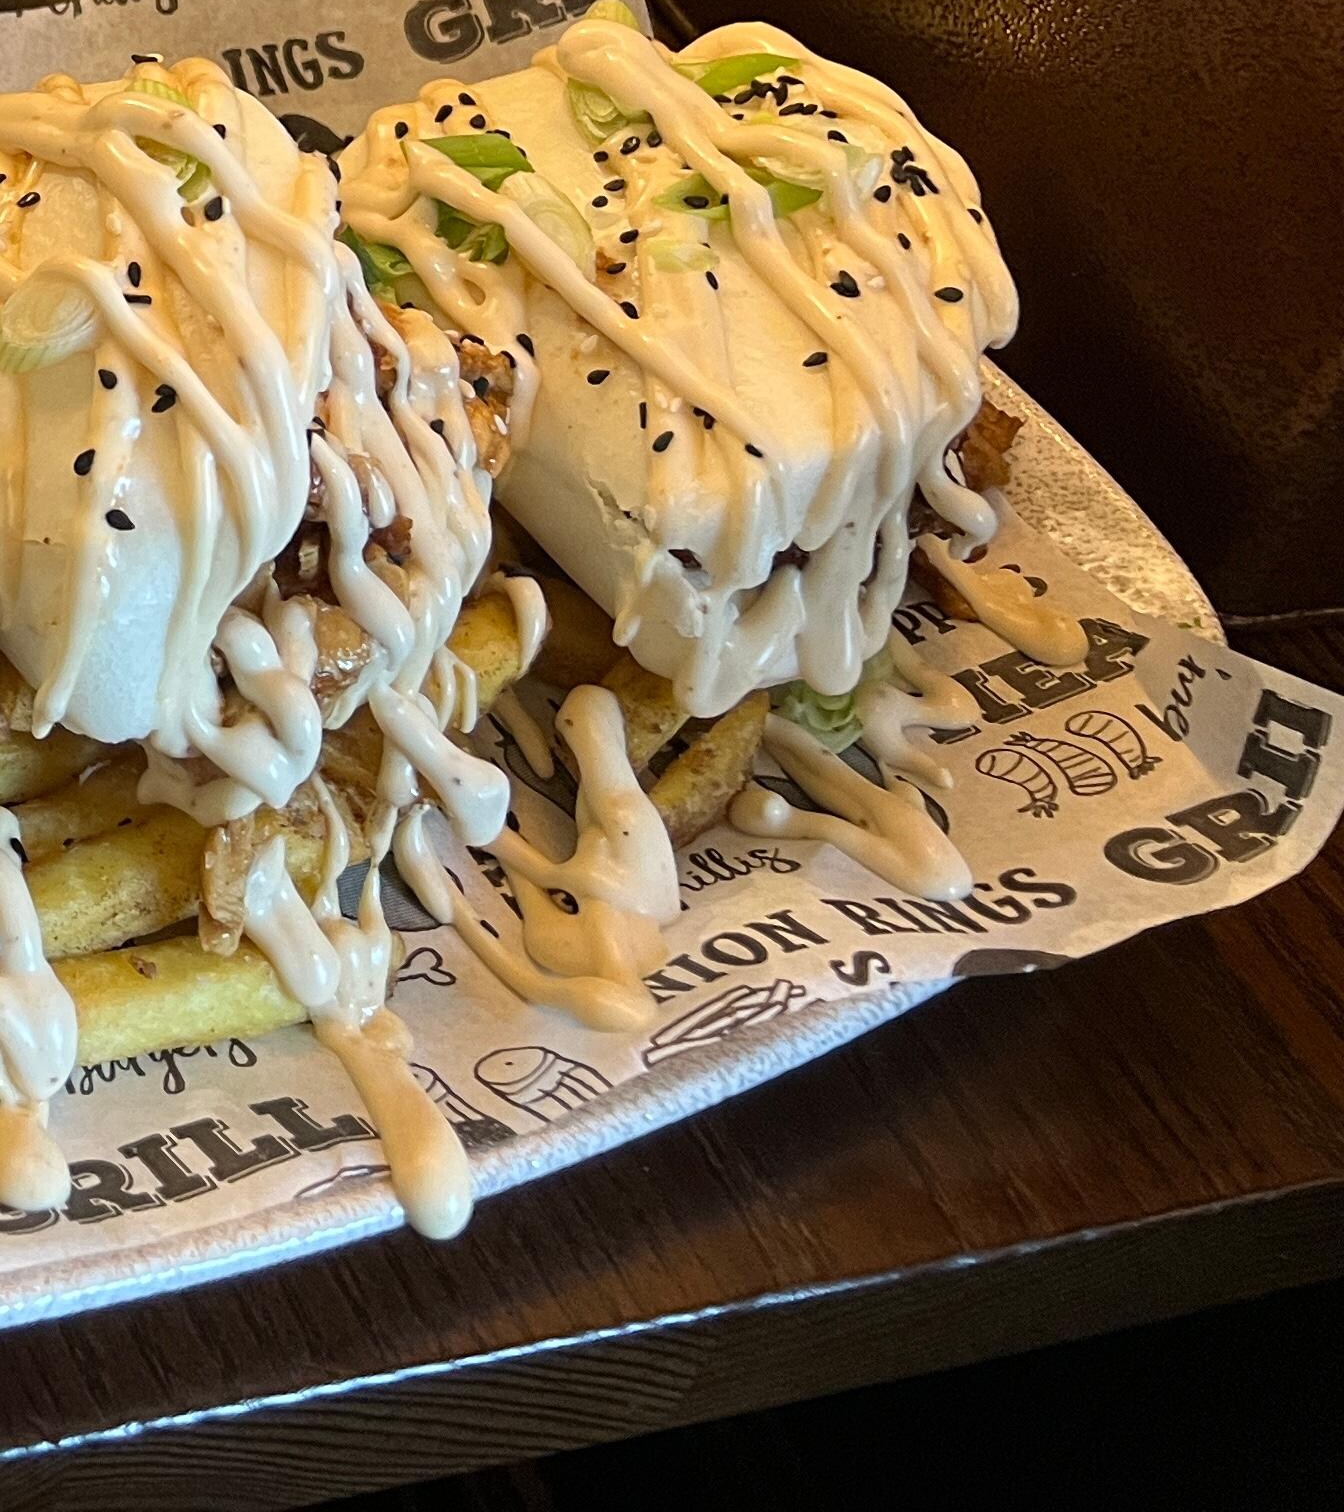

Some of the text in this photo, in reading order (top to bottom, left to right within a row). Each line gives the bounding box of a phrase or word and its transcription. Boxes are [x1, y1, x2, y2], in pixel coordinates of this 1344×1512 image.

[221, 30, 365, 97] INGS
[642, 908, 830, 1004] NION
[821, 867, 1077, 938] RINGS
